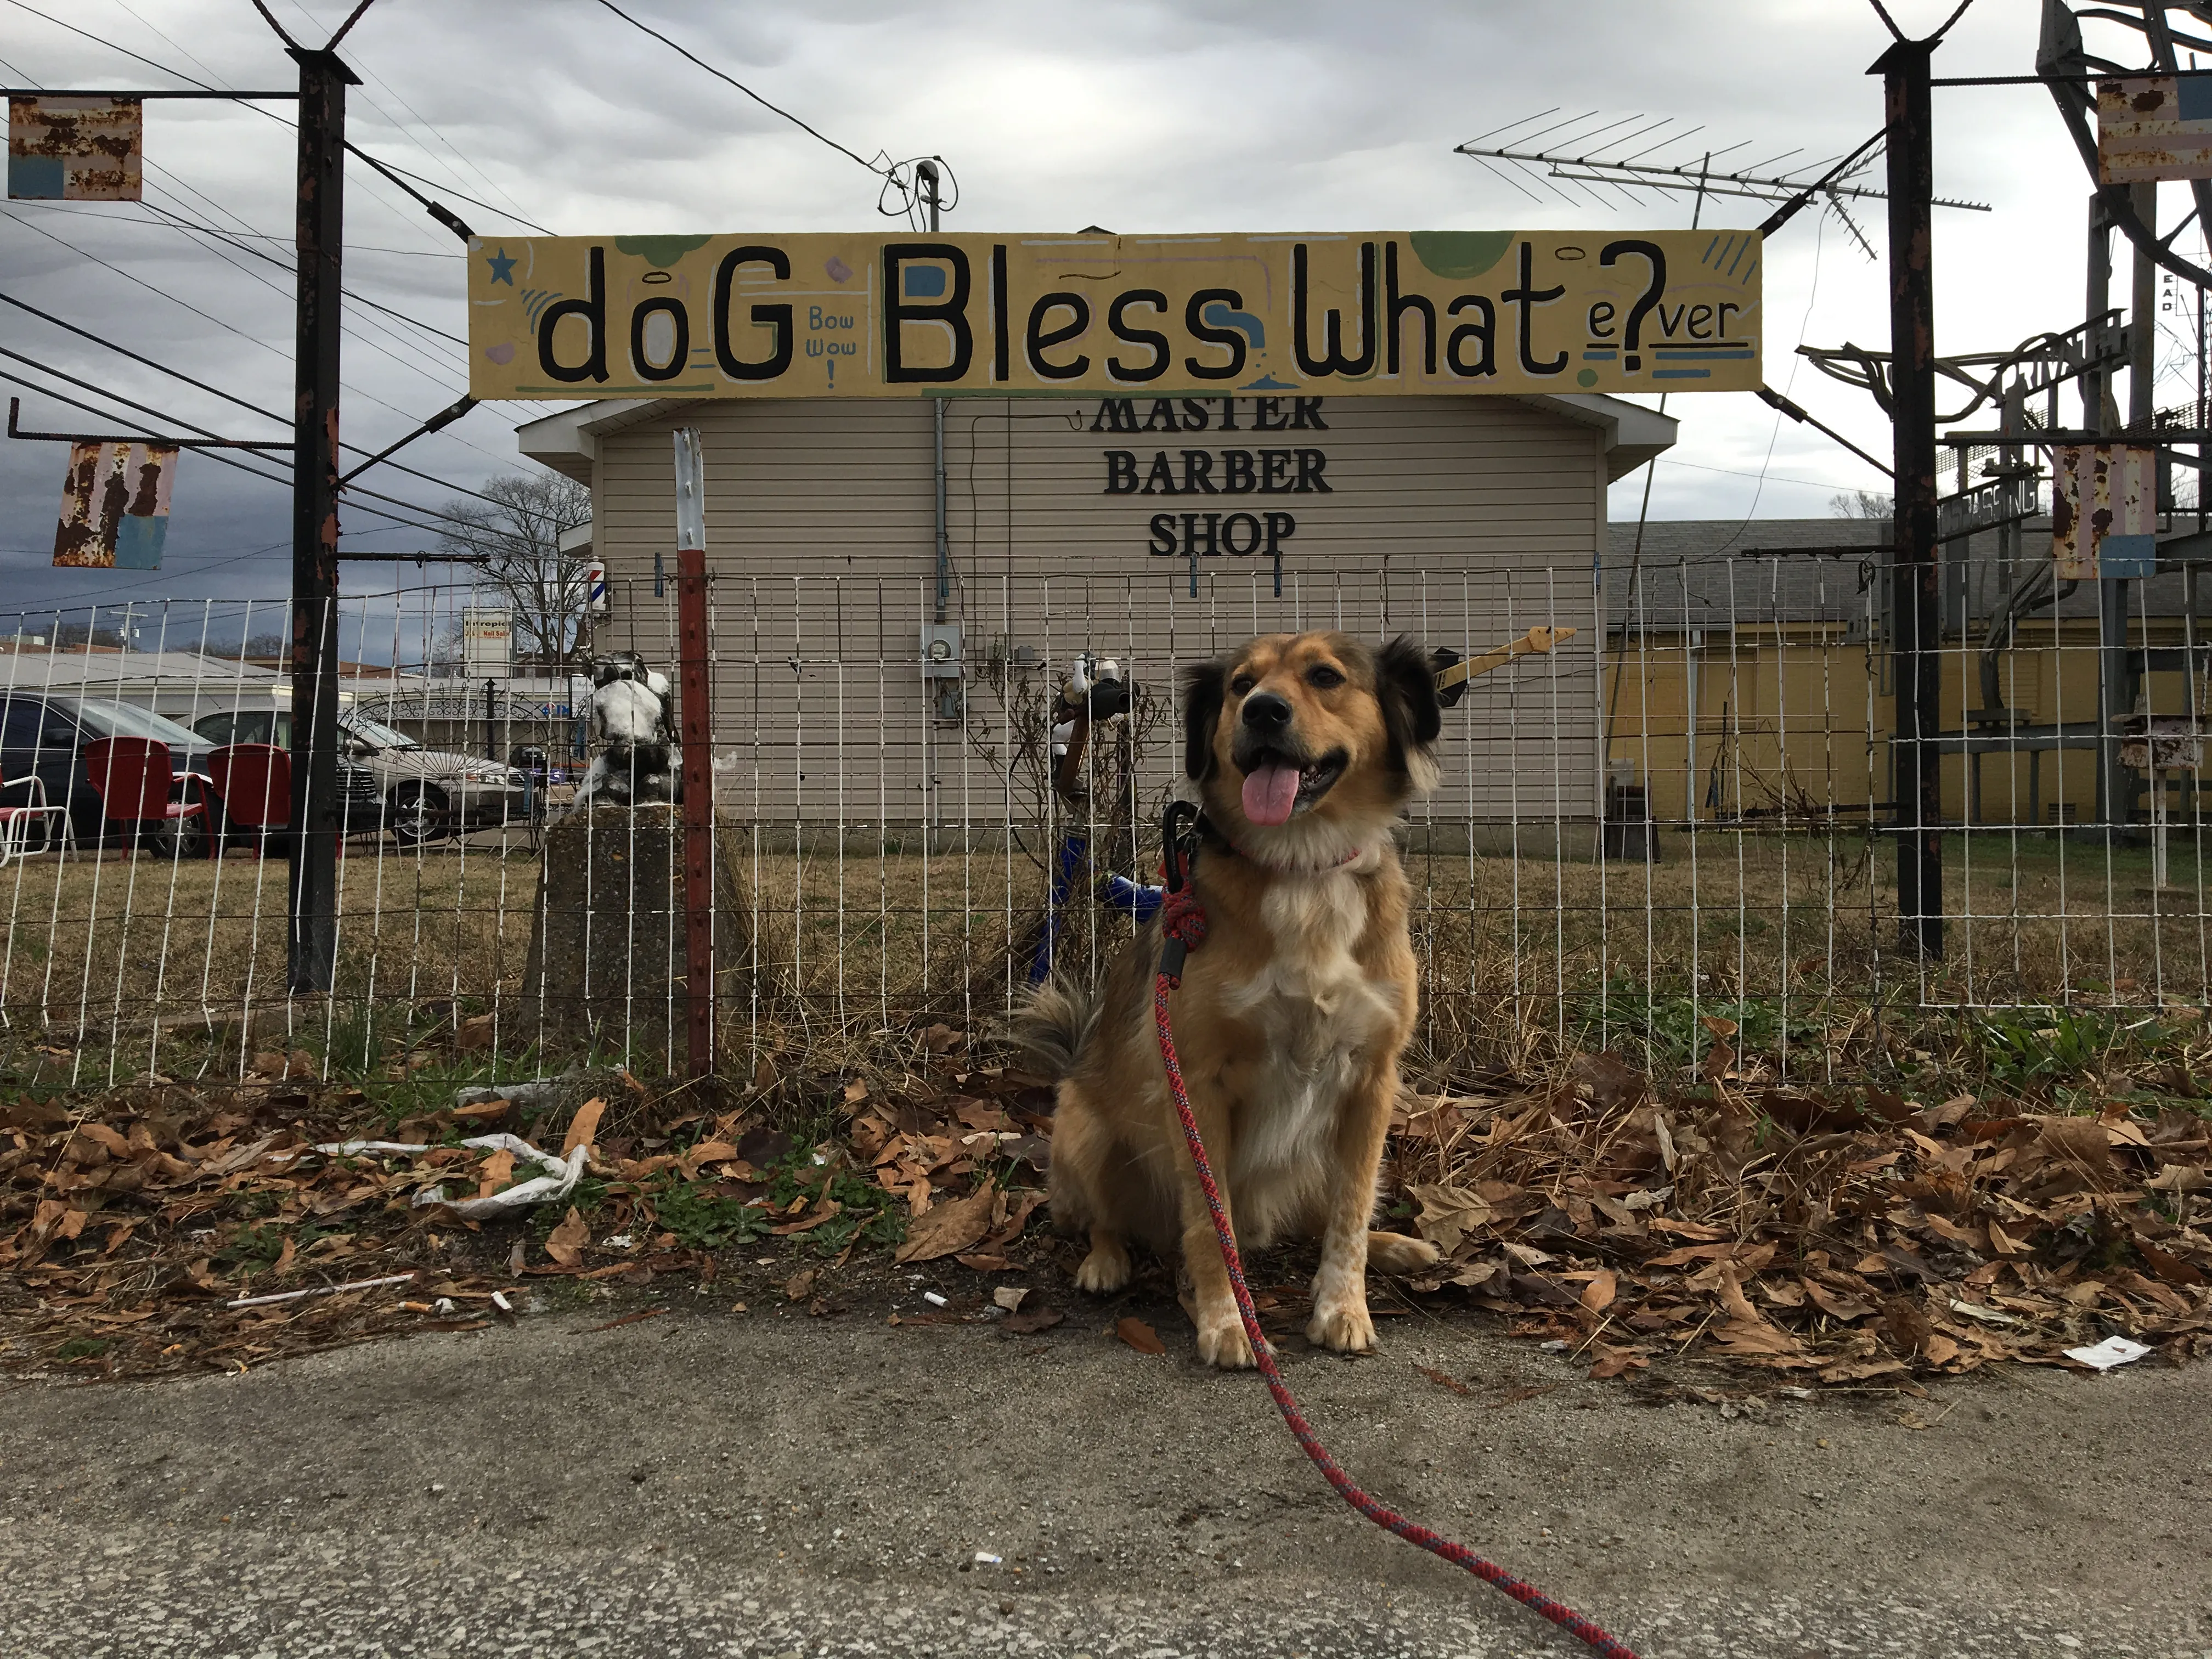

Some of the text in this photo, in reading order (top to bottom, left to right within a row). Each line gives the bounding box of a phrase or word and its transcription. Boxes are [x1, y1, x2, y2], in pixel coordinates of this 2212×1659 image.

[538, 245, 793, 383] doG
[884, 243, 1246, 383] Bless
[1294, 240, 1569, 377] What
[808, 305, 855, 330] Bow
[805, 337, 857, 357] Wow
[1089, 397, 1329, 432] MASTER
[1103, 448, 1333, 494] BARBER
[1149, 512, 1296, 556] SHOP
